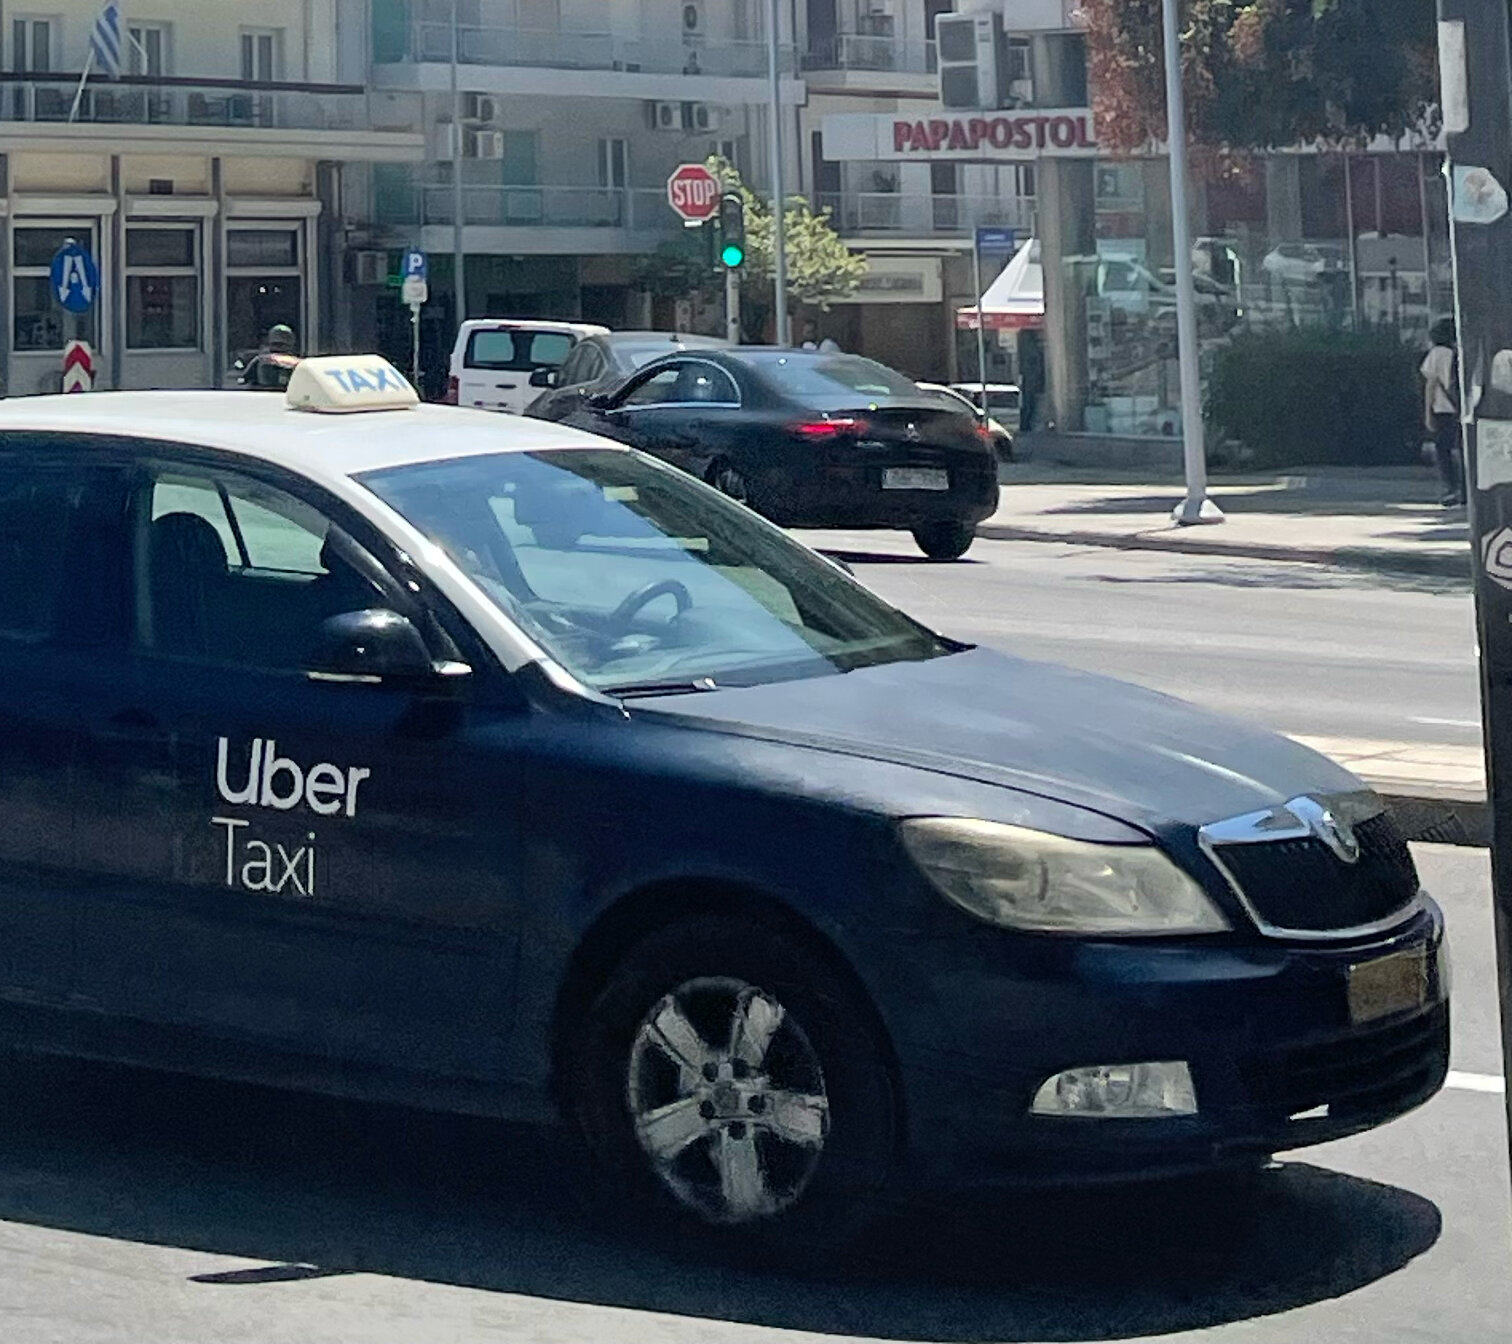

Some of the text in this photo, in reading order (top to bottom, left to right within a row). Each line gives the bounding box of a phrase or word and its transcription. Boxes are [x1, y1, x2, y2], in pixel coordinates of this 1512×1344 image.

[673, 178, 716, 206] STOP
[408, 253, 423, 273] P
[324, 367, 409, 393] TAXI
[216, 736, 371, 817] Uber
[210, 816, 314, 896] Taxi
